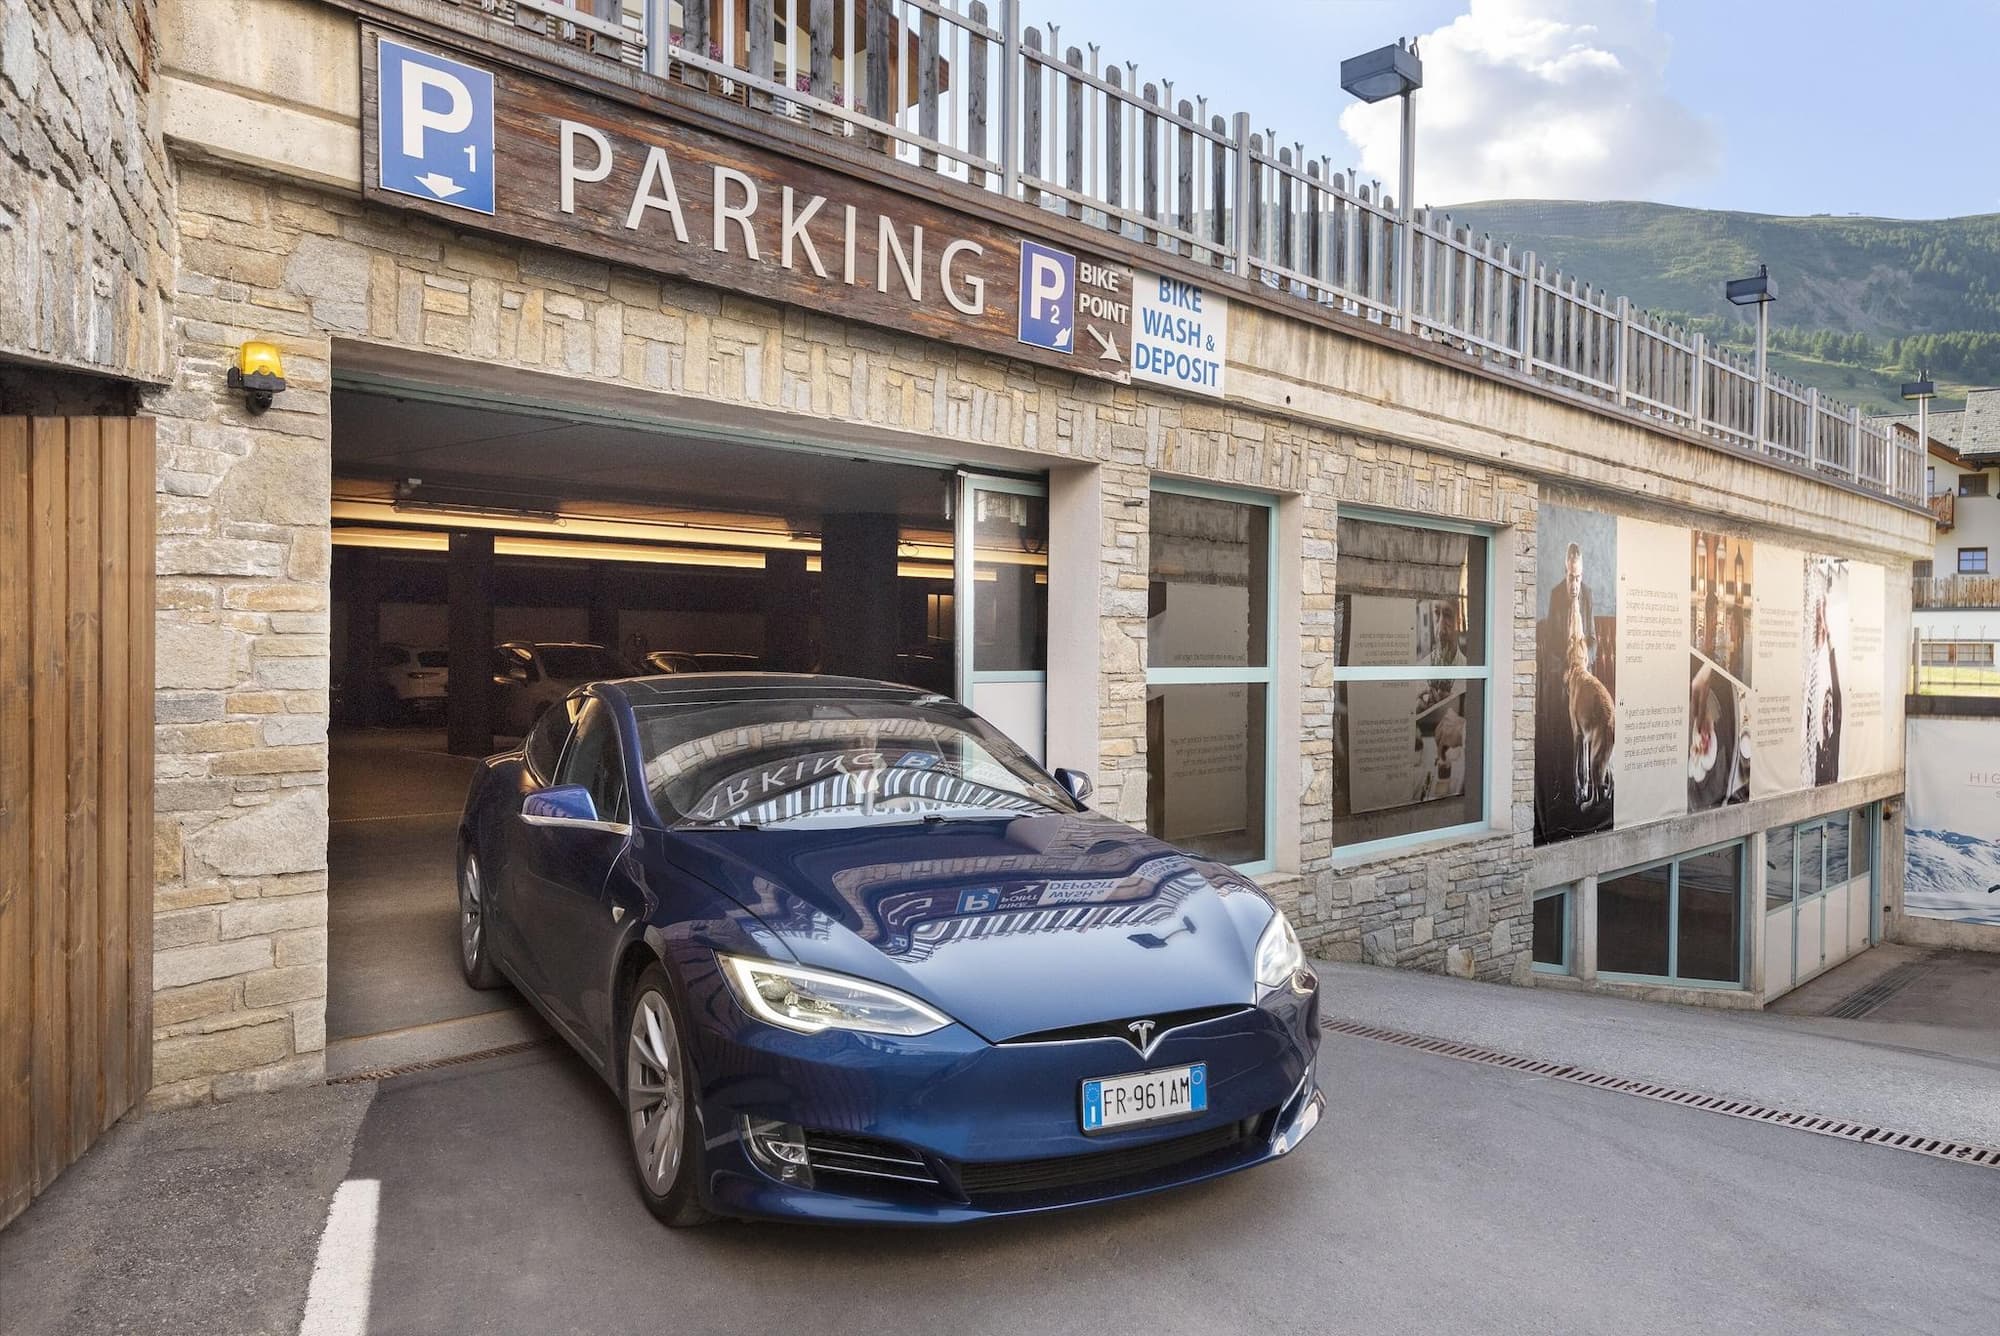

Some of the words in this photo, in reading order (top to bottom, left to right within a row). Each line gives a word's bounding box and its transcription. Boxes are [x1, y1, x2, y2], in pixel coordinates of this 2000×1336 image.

[402, 59, 473, 159] P
[463, 144, 477, 173] 1
[559, 119, 985, 315] PARKING
[1030, 252, 1066, 320] P
[1050, 304, 1060, 325] 2
[1079, 261, 1119, 293] BIKE
[1158, 275, 1203, 314] BIKE
[1079, 293, 1130, 325] POINT
[1142, 306, 1201, 349] WASH
[1205, 334, 1215, 353] &
[1135, 342, 1220, 388] DEPOSIT
